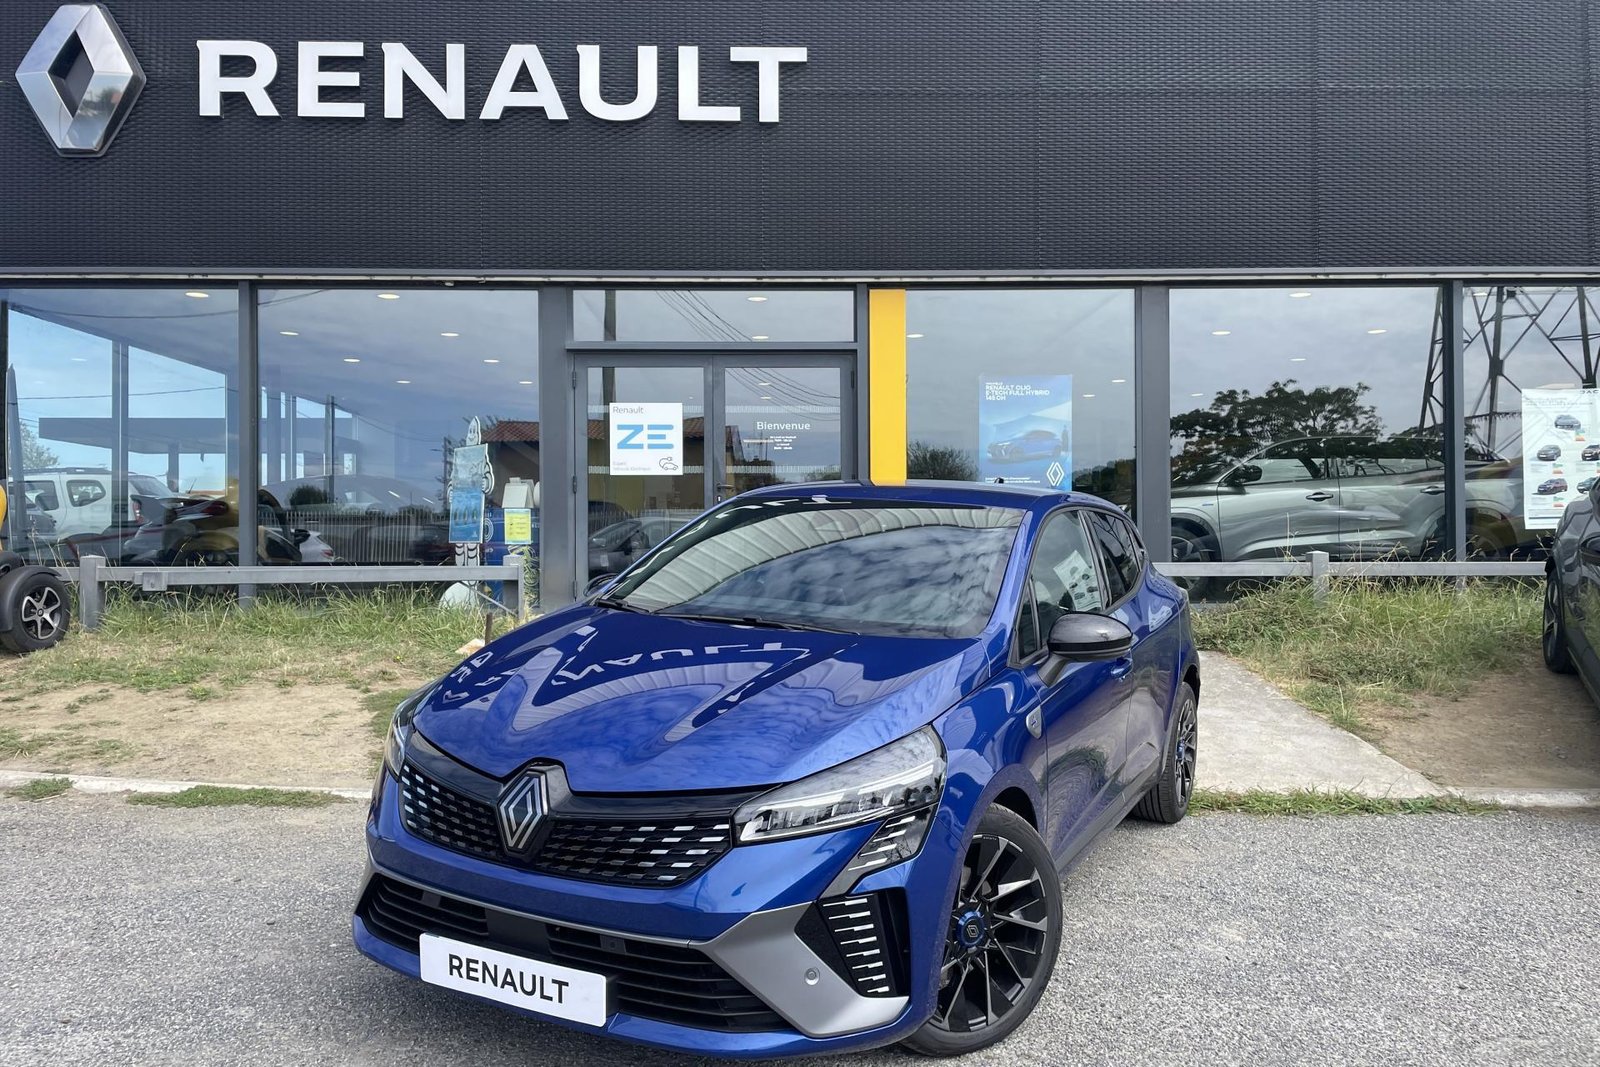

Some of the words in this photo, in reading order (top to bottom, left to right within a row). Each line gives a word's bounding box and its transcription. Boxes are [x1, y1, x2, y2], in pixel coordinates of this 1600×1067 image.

[197, 39, 807, 123] RENAULT
[612, 406, 645, 414] Renault
[617, 424, 674, 449] ZE
[756, 421, 811, 430] Bienvenue
[448, 953, 569, 1004] RENAULT
